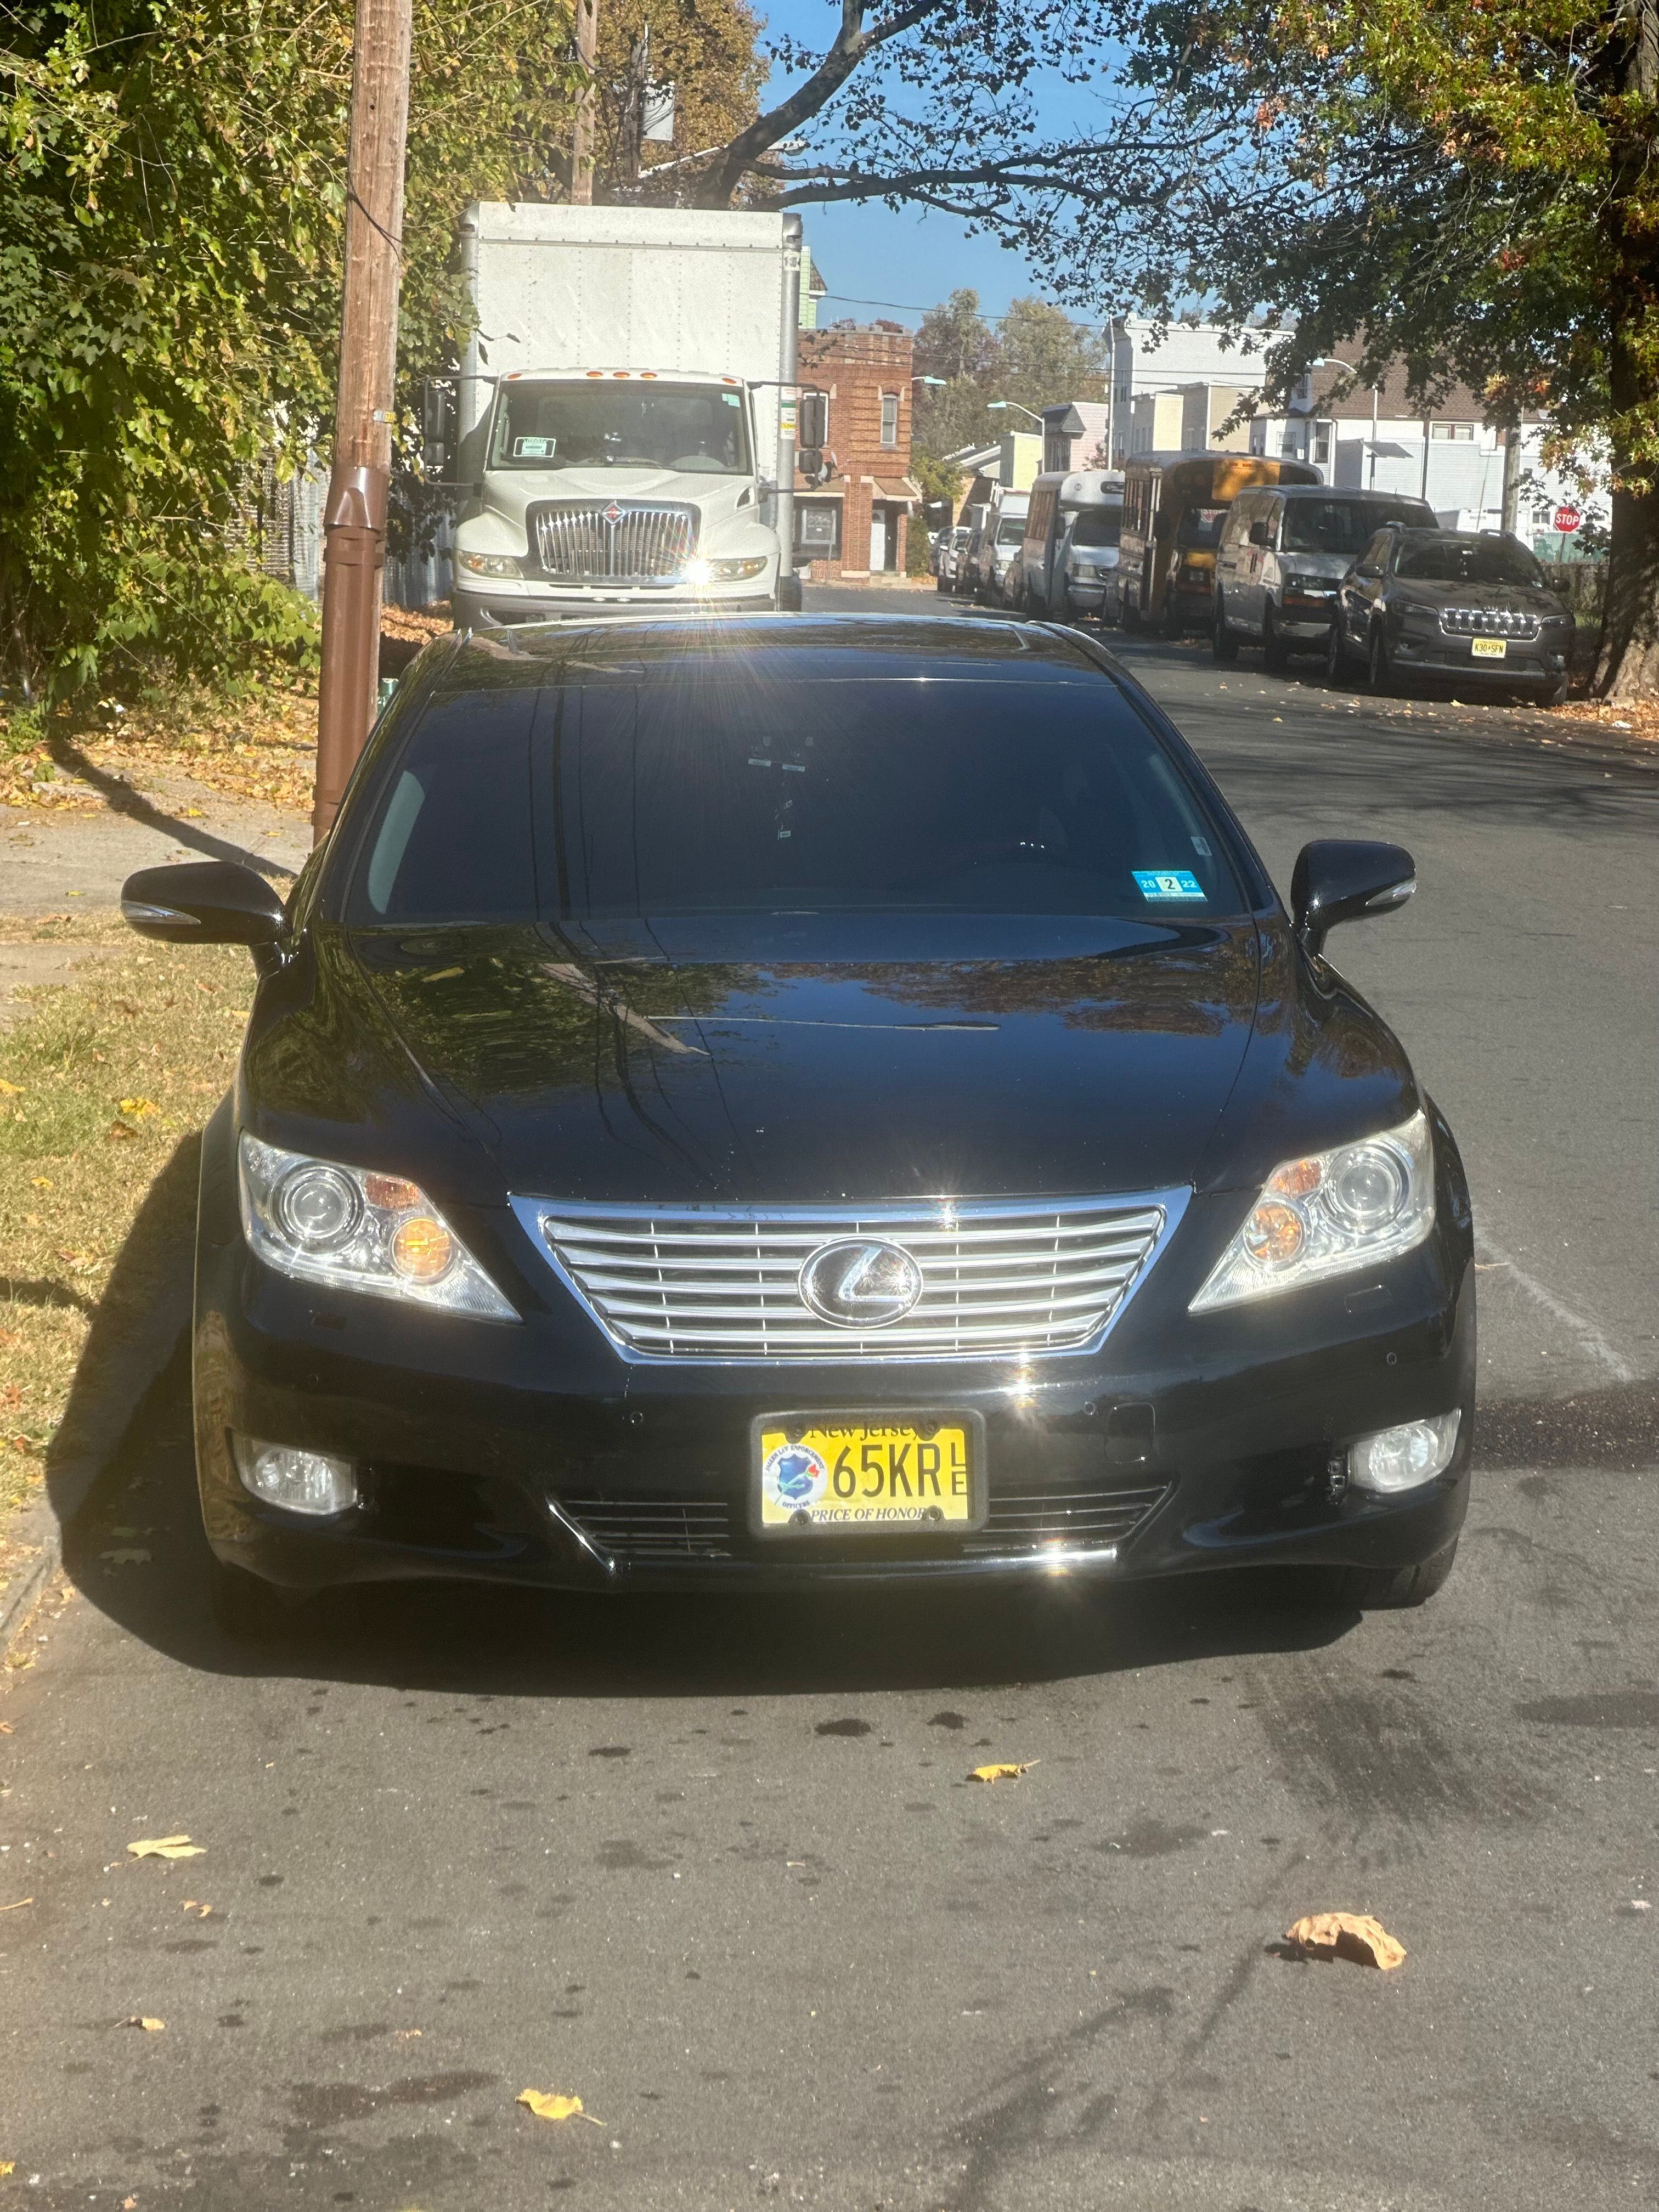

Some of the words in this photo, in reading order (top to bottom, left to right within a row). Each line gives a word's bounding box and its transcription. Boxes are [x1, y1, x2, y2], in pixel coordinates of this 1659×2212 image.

[1555, 513, 1579, 526] STOP
[1475, 643, 1487, 652] K30
[1141, 879, 1156, 888] 20
[1164, 878, 1176, 890] 2
[1181, 880, 1197, 888] 22
[809, 1423, 856, 1438] New
[777, 1446, 789, 1455] LAW
[791, 1444, 825, 1470] ENFORCEMENT
[833, 1443, 941, 1498] 65KR
[782, 1500, 810, 1509] OFFICERS
[810, 1509, 851, 1521] PRICE
[854, 1509, 874, 1520] OF
